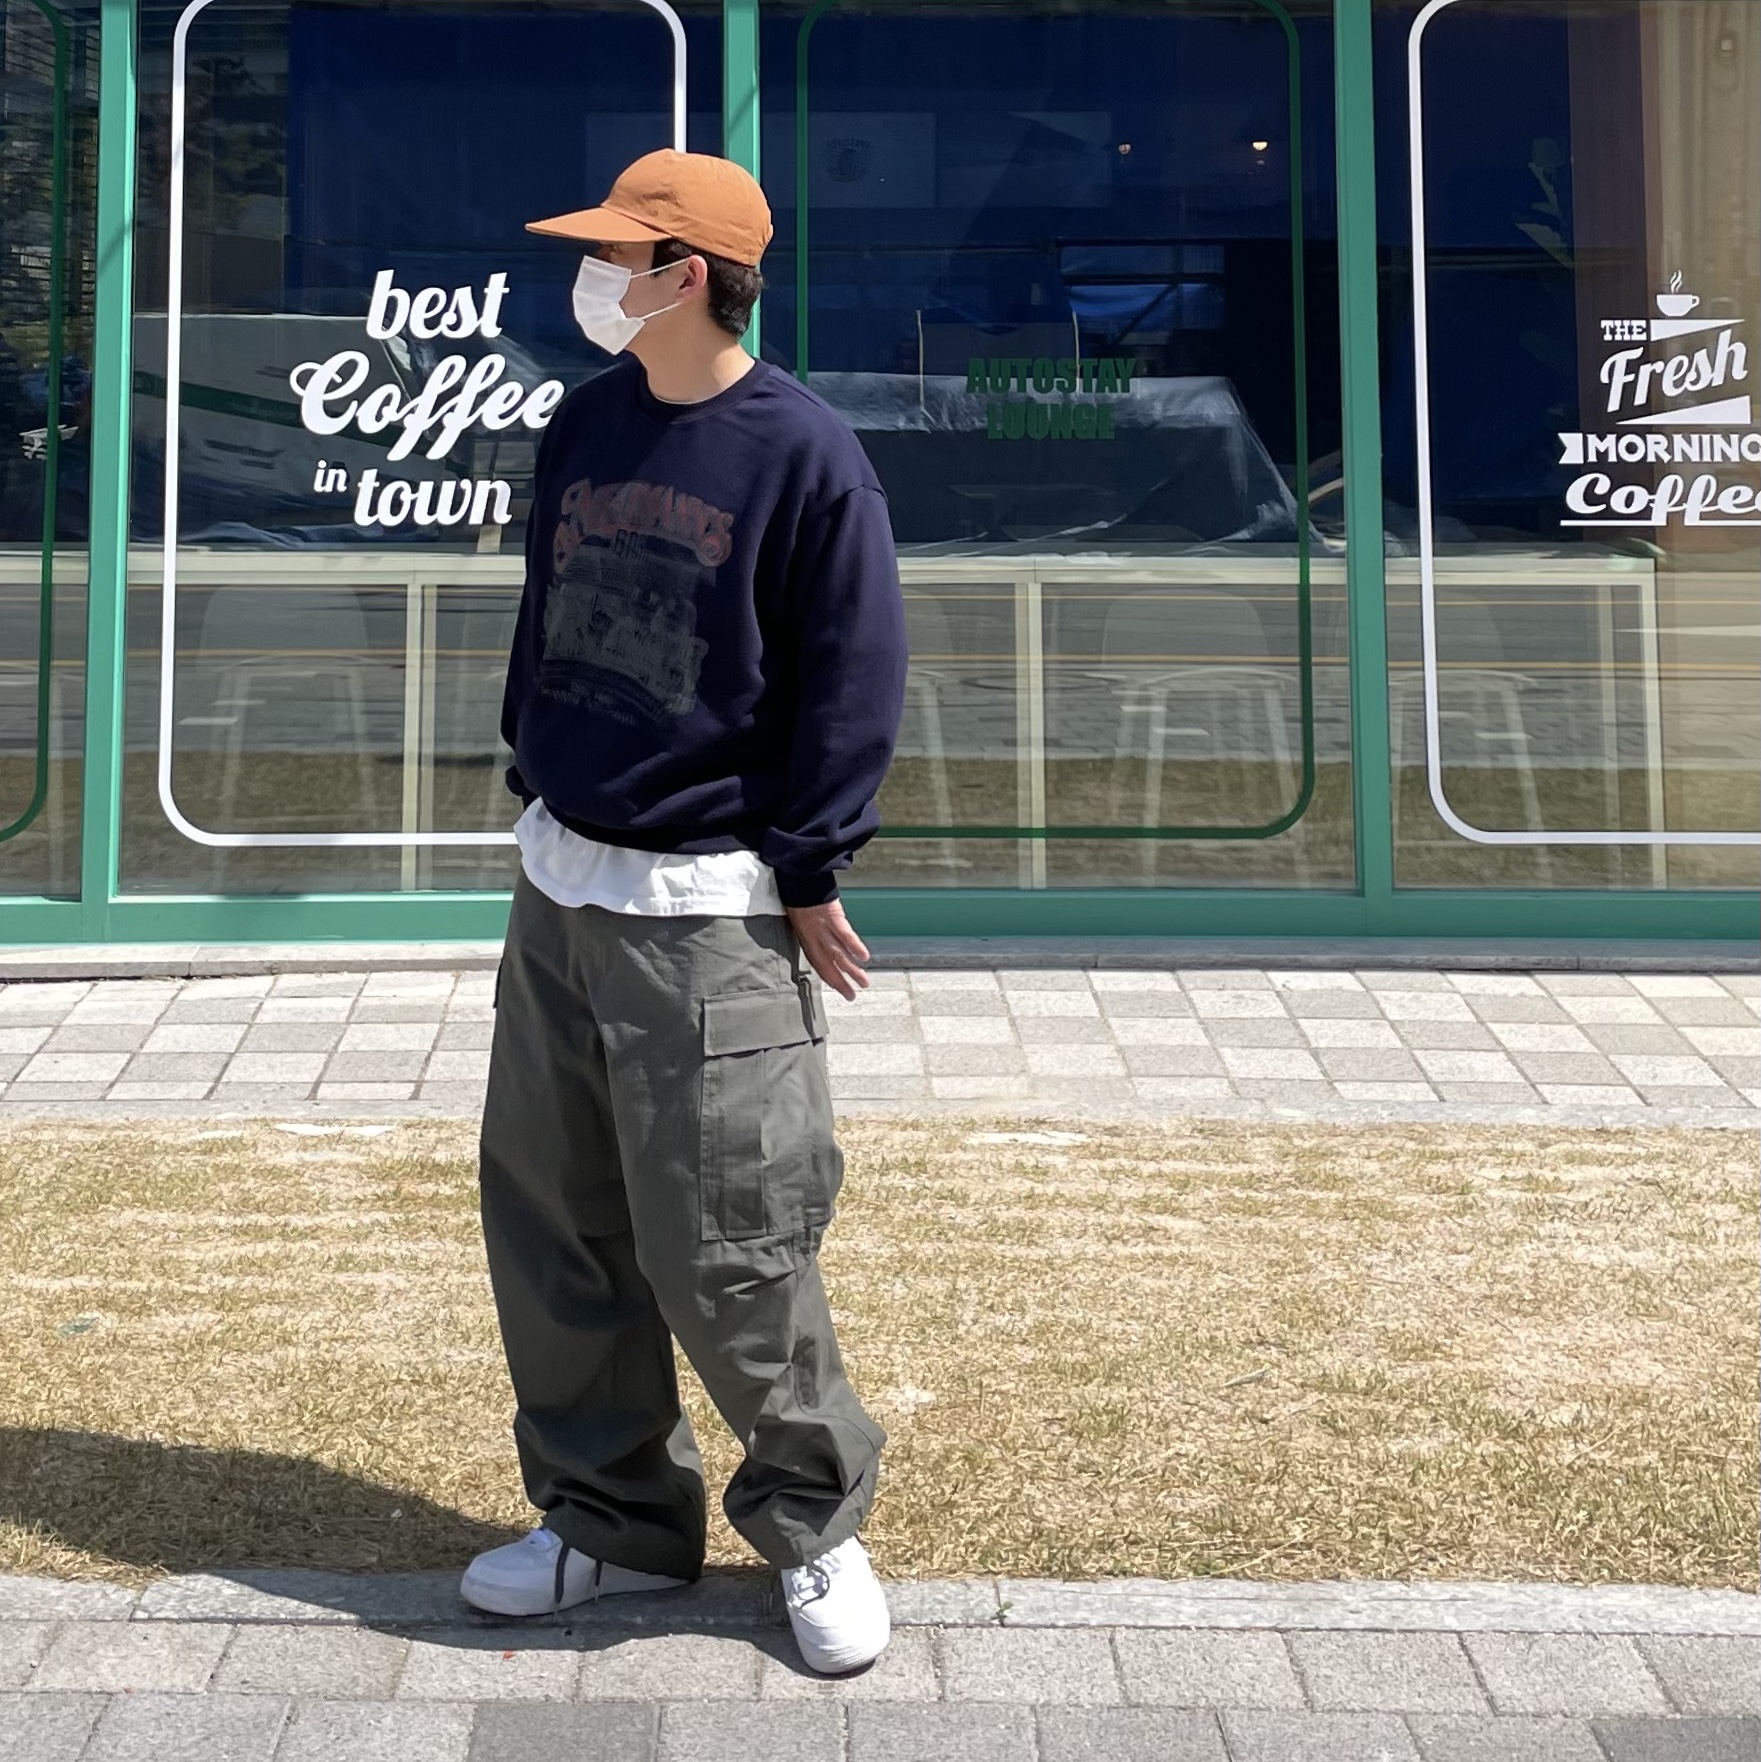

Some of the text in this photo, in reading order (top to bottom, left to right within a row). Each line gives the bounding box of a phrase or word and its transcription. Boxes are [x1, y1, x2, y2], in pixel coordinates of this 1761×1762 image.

[366, 269, 510, 339] best
[1600, 319, 1647, 341] THE
[967, 358, 1137, 394] AUTOSTAY
[1600, 329, 1748, 412] Fresh
[289, 350, 565, 461] Coffee
[987, 402, 1116, 440] LOUNGE
[313, 459, 347, 493] in
[354, 468, 513, 527] town
[1565, 472, 1761, 526] Coffe
